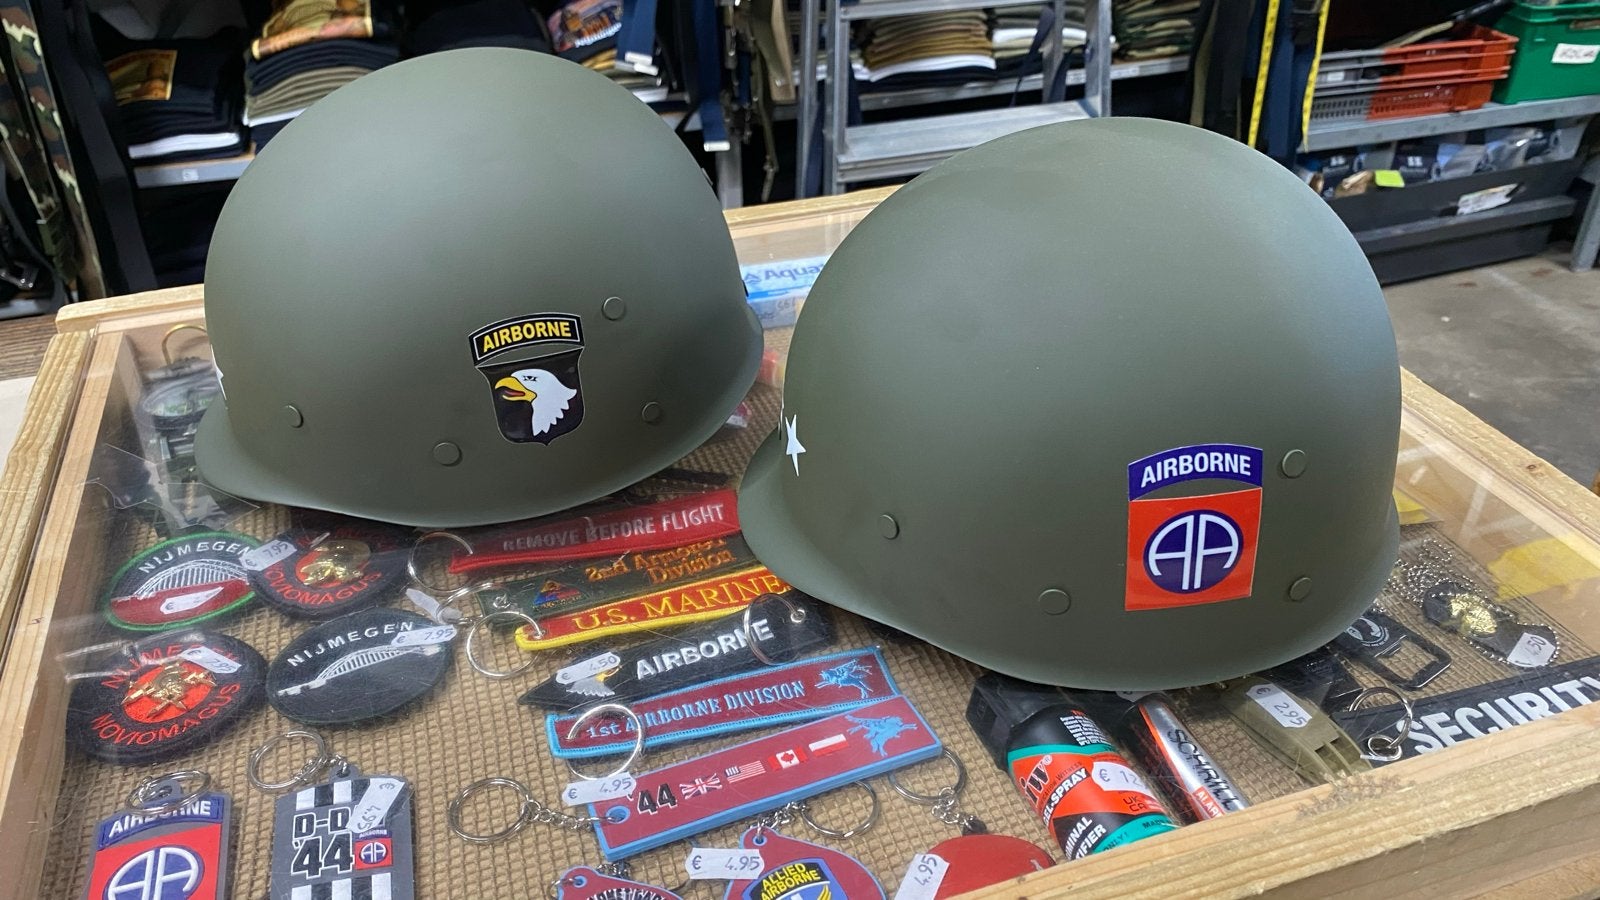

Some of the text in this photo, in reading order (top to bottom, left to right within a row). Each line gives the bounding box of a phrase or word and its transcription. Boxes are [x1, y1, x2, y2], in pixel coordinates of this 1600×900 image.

[764, 263, 824, 280] Aqua
[483, 320, 572, 353] AIRBORNE
[1141, 452, 1251, 488] AIRBORNE
[503, 503, 725, 551] REMOVE BEFORE FLIGHT
[263, 541, 289, 558] 7.95
[649, 549, 736, 584] Division
[263, 561, 382, 605] OVIOMAGUS
[572, 574, 791, 630] U.S. MARINE
[287, 621, 414, 667] NIJMEGEN
[424, 628, 455, 641] 7.95
[636, 618, 774, 680] AIRBORNE
[91, 683, 241, 746] NOVIOMAGUS
[586, 680, 806, 738] 1st AIRBORNE DIVISION
[1273, 702, 1308, 726] 2.95
[599, 777, 632, 793] 4.95
[1196, 789, 1222, 818] ALAR
[724, 856, 760, 871] 4.95
[762, 863, 806, 891] ALLIED
[914, 855, 938, 887] 4.95
[761, 869, 821, 900] AIRBORNE
